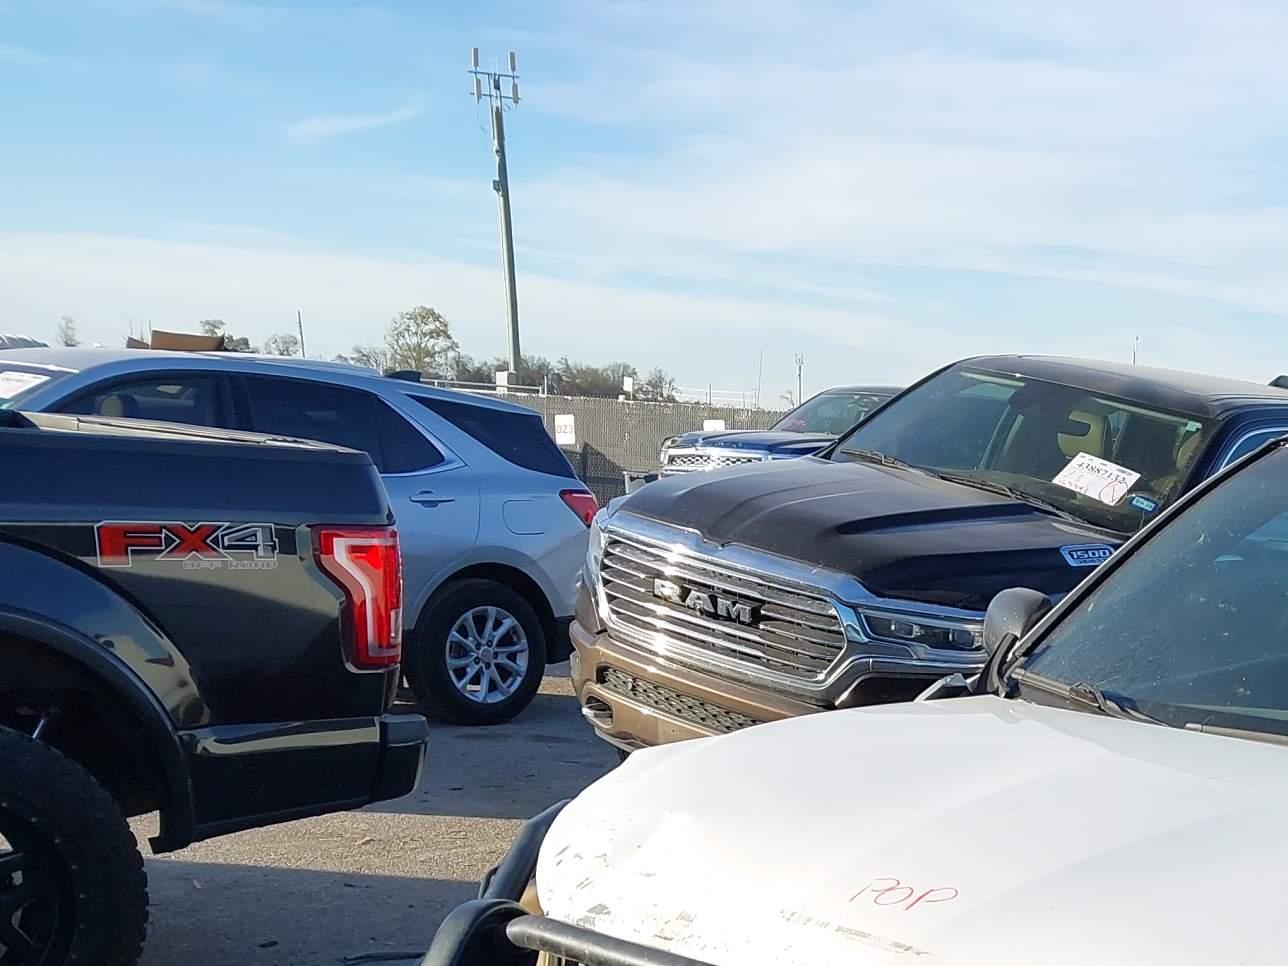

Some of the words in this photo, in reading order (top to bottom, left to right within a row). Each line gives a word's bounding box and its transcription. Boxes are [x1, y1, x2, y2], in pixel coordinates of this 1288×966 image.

[94, 520, 279, 568] FX4
[1070, 549, 1111, 559] 1500
[653, 578, 756, 624] RAM
